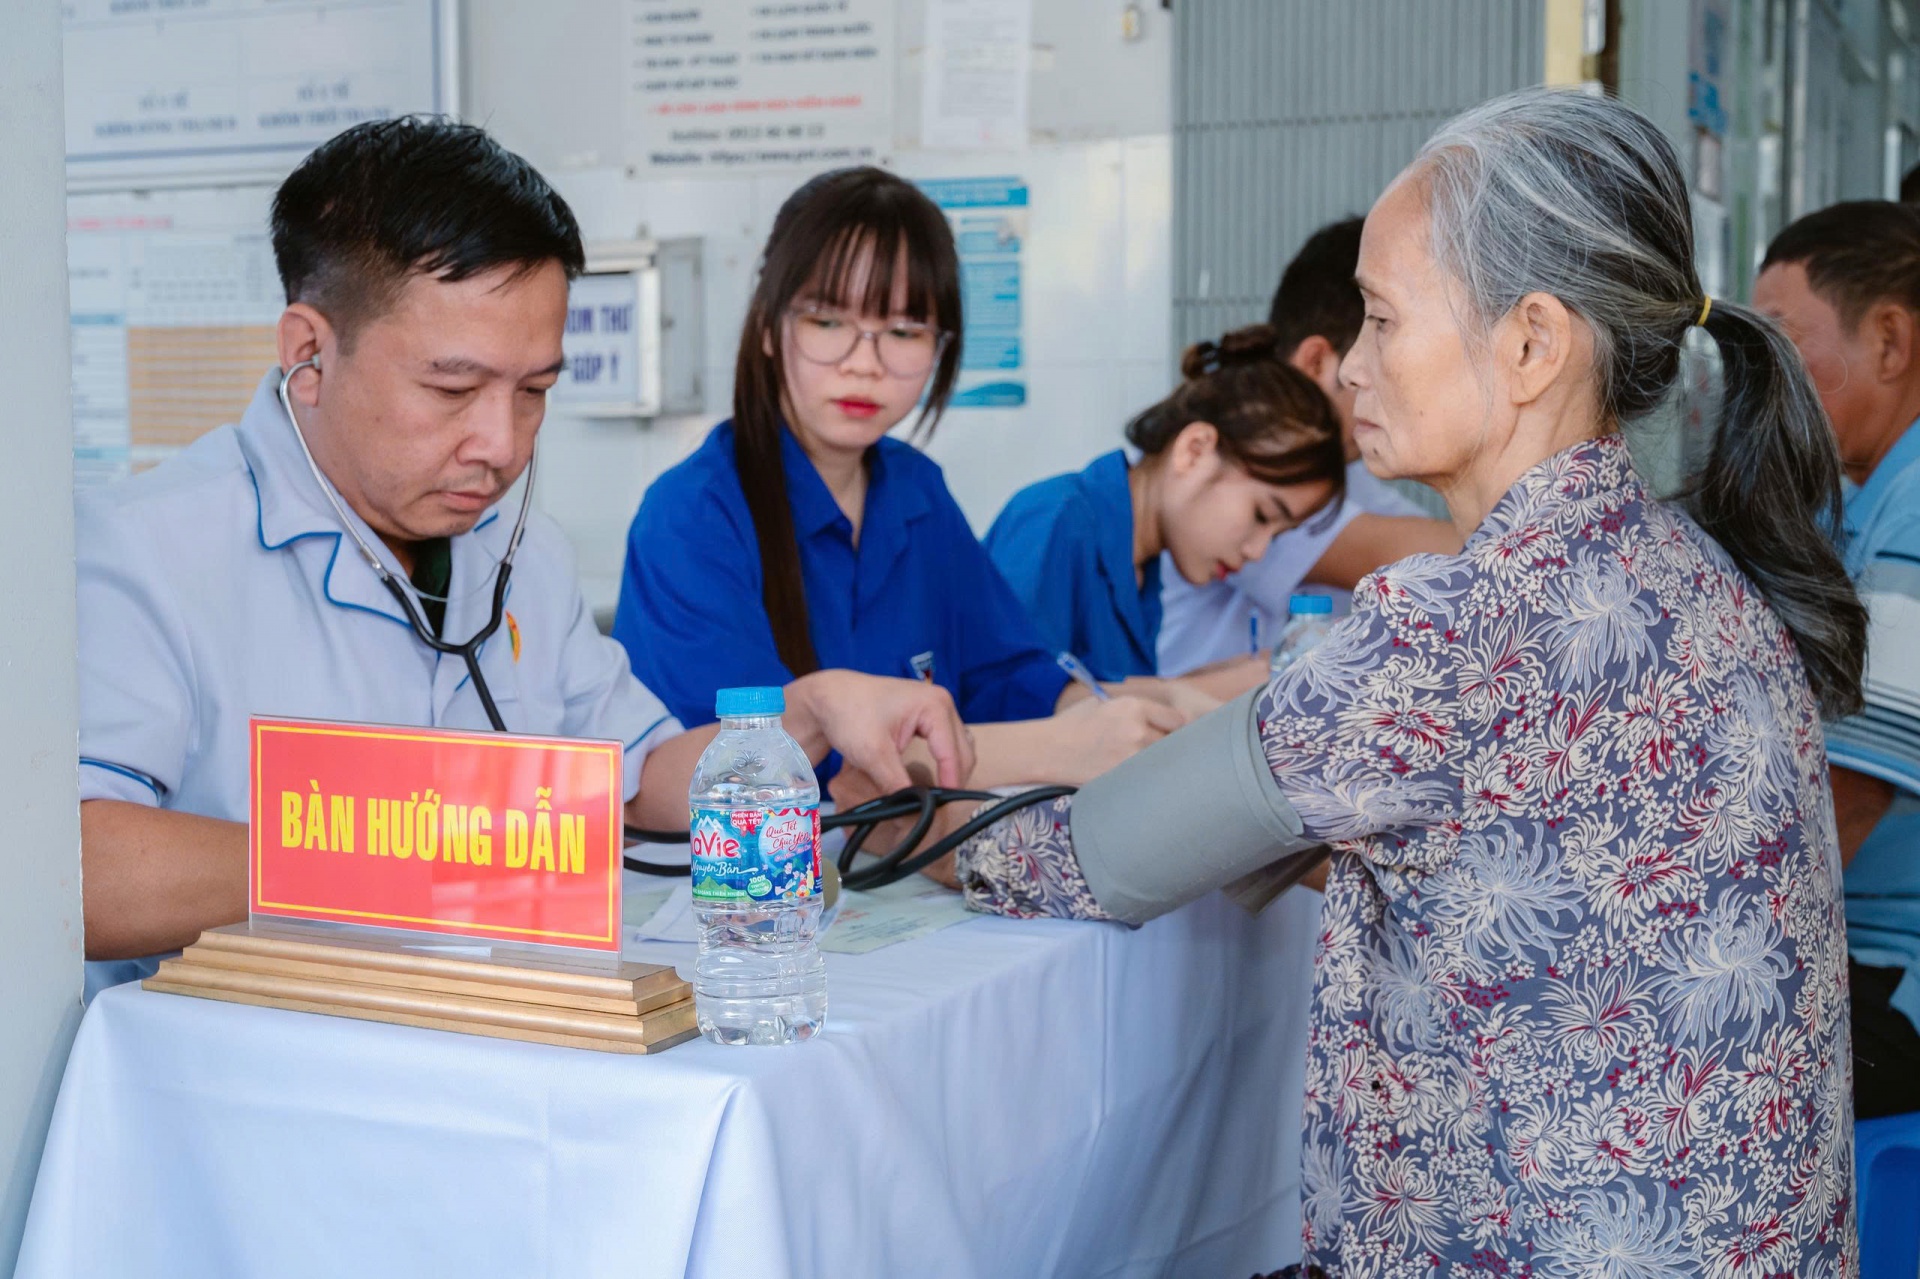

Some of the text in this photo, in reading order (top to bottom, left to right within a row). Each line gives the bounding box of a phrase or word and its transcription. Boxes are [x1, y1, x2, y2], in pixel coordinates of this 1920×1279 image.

[281, 779, 586, 875] BÀN HƯỚNG DẪN
[693, 829, 740, 859] aVie
